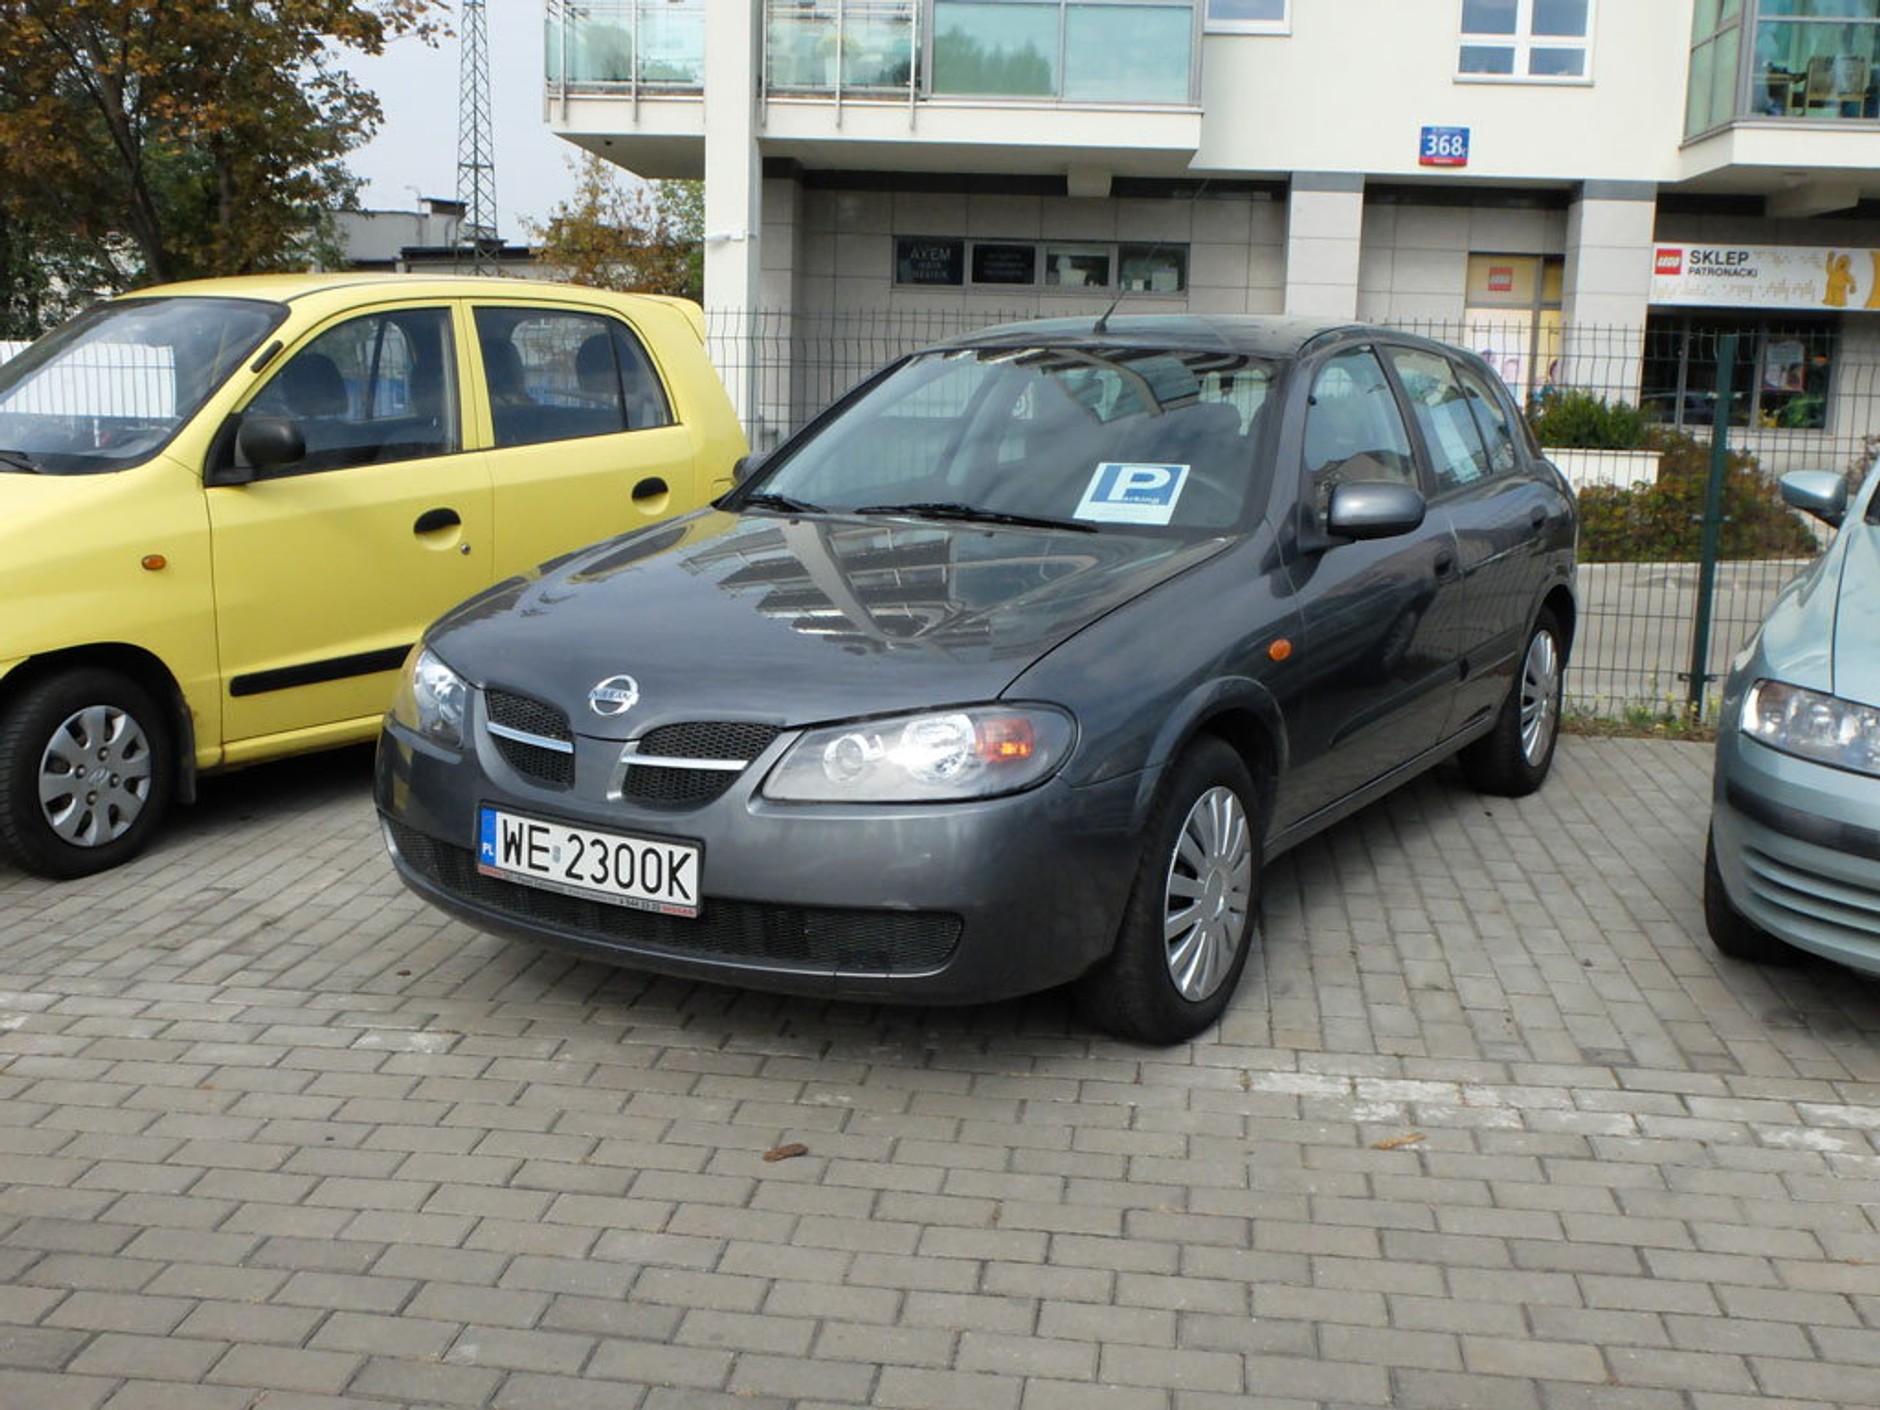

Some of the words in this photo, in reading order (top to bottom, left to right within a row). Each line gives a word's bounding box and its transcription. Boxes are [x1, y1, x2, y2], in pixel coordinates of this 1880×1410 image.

[1425, 135, 1463, 156] 368
[1689, 250, 1749, 266] SKLEP
[1688, 266, 1758, 277] PATRONACKI
[503, 819, 550, 872] WE
[565, 834, 691, 900] 2300K
